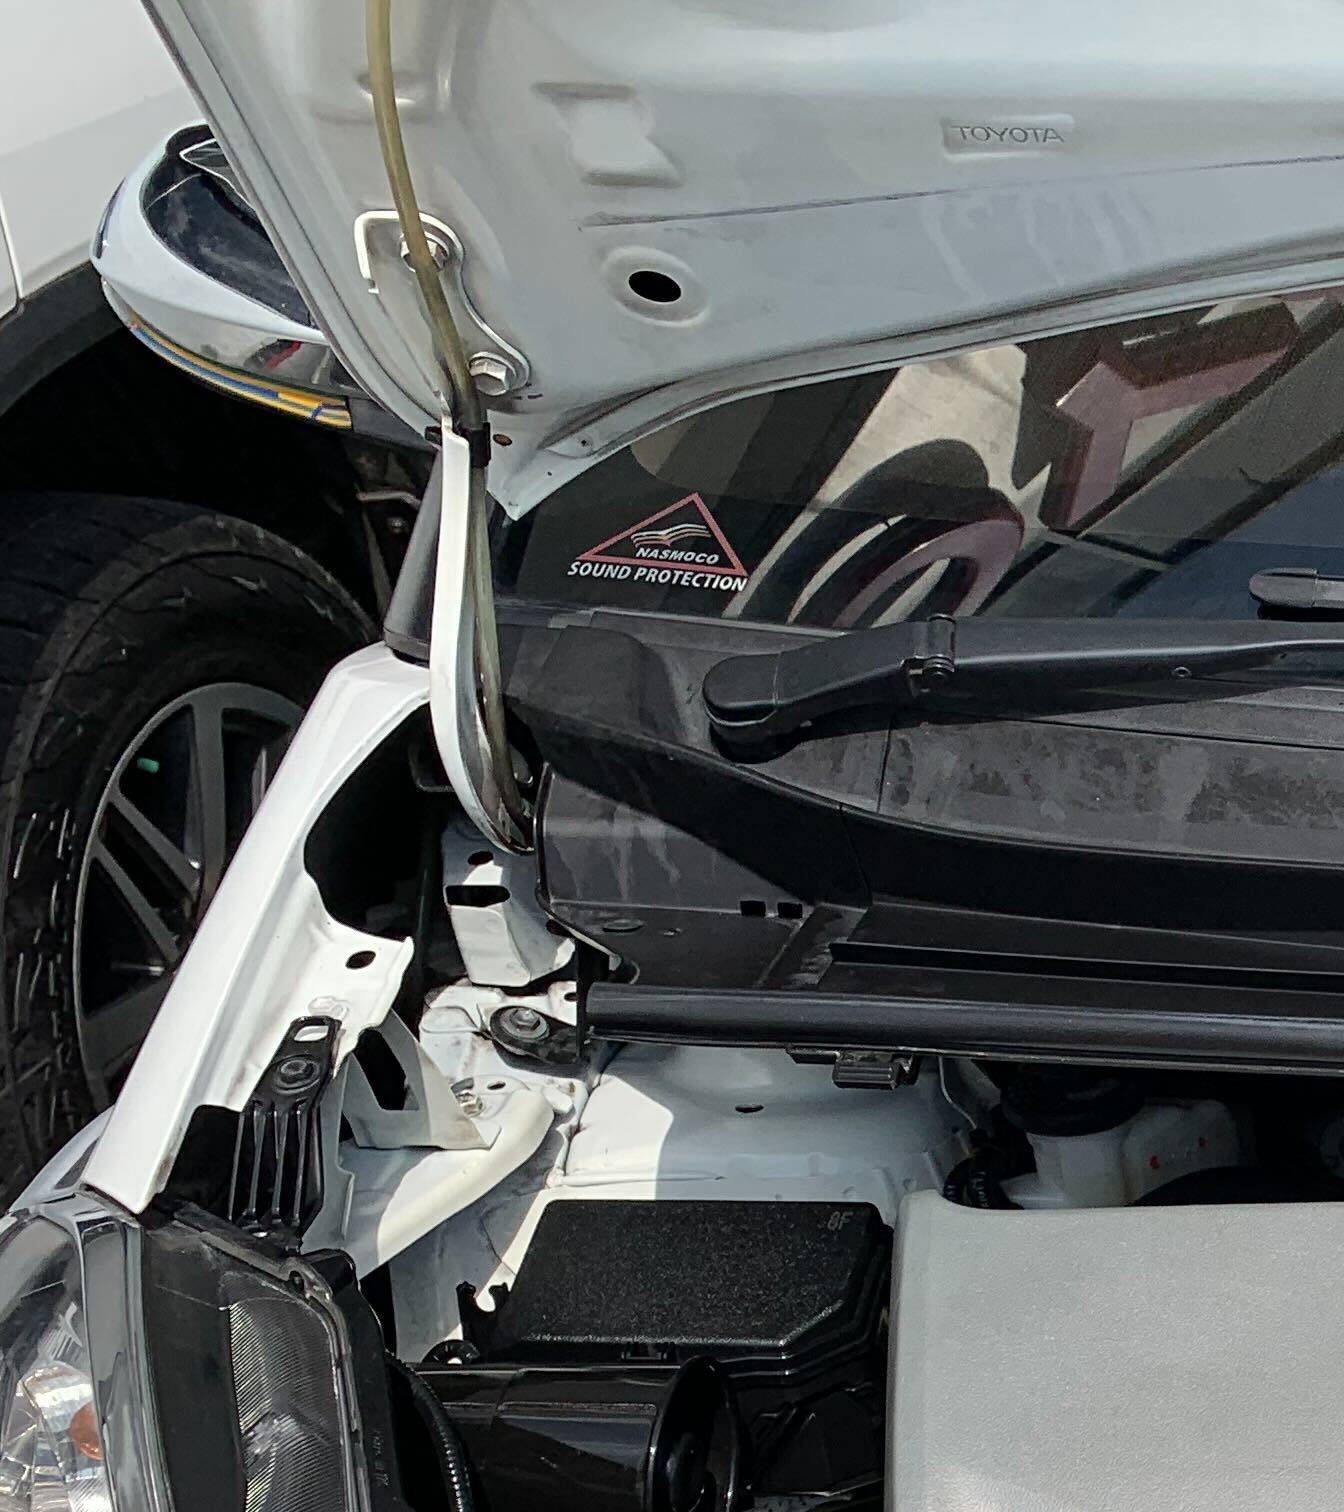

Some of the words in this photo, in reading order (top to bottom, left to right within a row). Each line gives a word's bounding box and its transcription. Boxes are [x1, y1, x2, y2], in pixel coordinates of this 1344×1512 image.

[951, 125, 1065, 144] TOYOTA
[635, 547, 720, 565] NASMOCO
[567, 560, 632, 581] SOUND
[633, 567, 749, 592] PROTECTION
